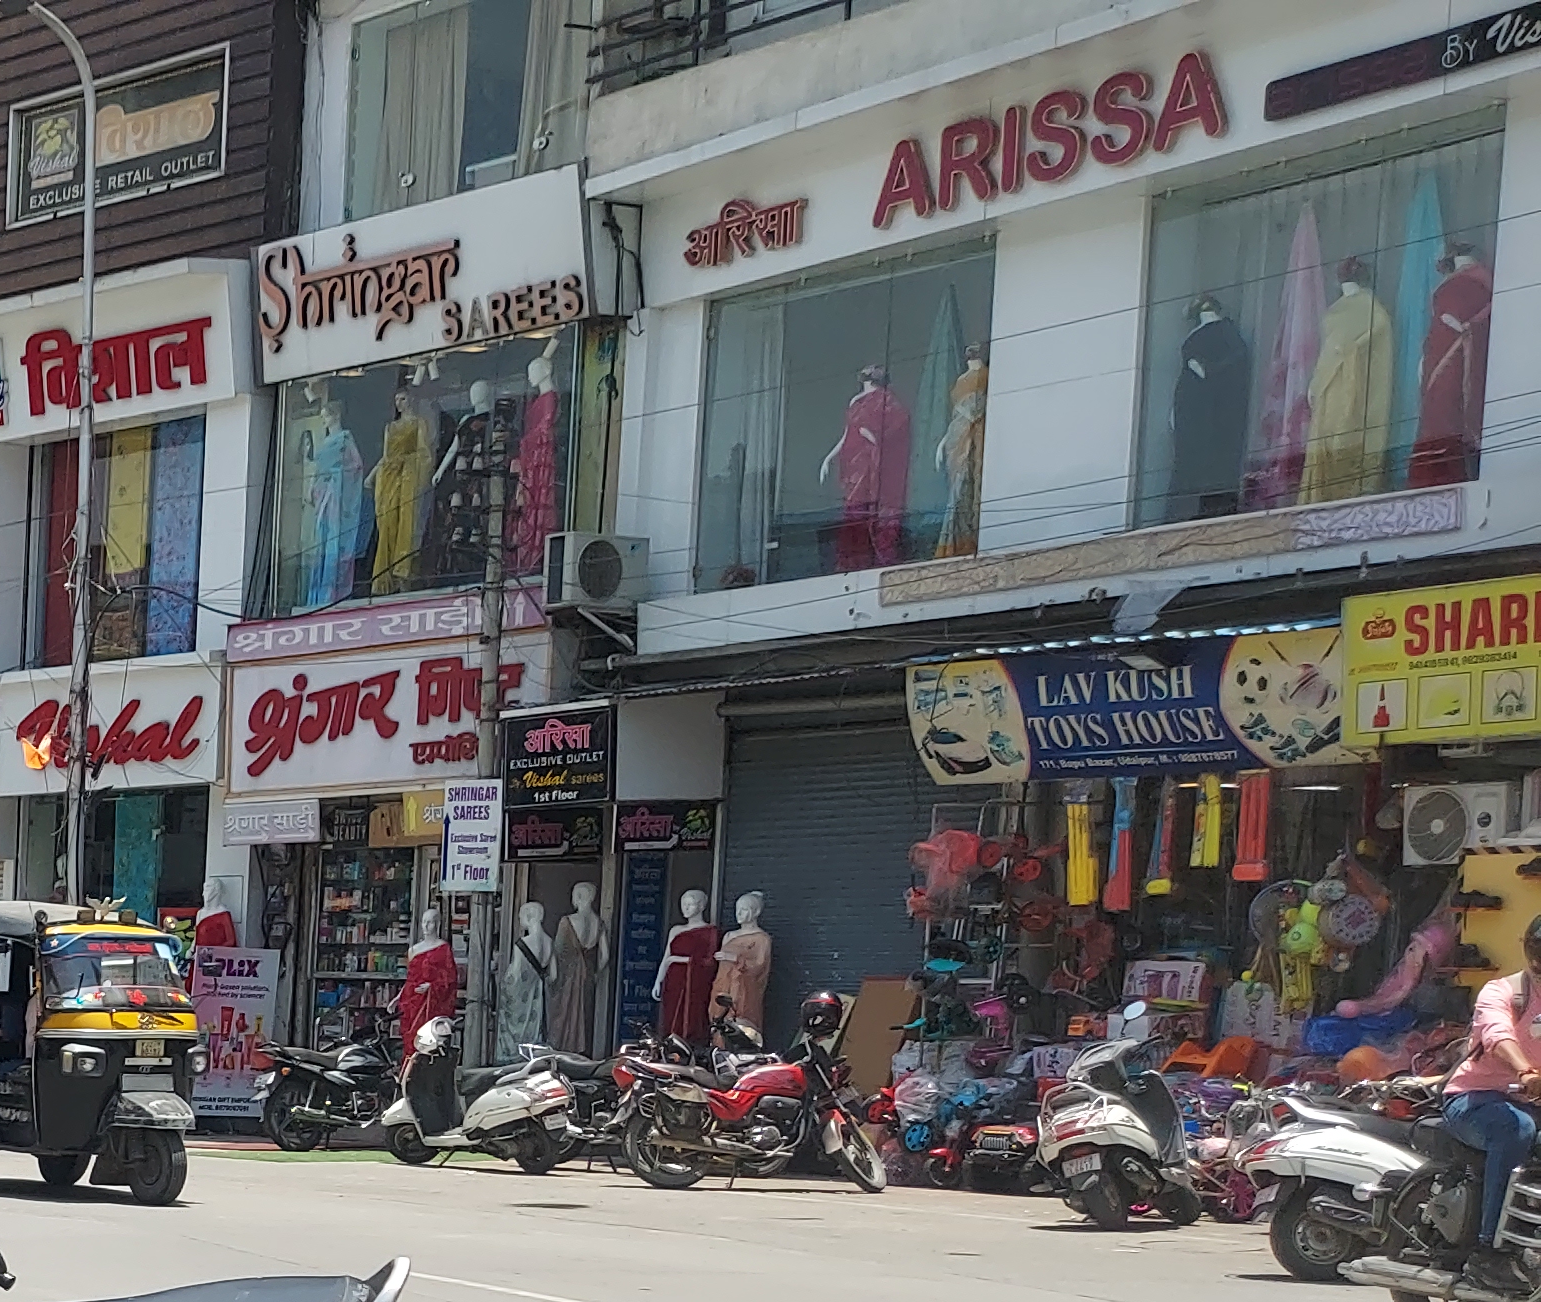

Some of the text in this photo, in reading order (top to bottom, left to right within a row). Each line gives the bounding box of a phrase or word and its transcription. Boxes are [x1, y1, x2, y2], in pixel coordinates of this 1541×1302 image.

[872, 49, 1229, 230] ARISSA
[29, 180, 101, 210] EXCLUSIE
[108, 167, 154, 191] RETAIL
[161, 150, 215, 176] OUTLET
[683, 198, 809, 268] अरिसा
[260, 233, 584, 354] Shringar SAREES
[20, 320, 212, 417] विशाल
[1404, 591, 1541, 656] SHAR
[1036, 665, 1196, 707] LAV KUSH
[524, 718, 592, 753] अरिसा
[1027, 706, 1225, 750] TOYS HOUSE
[447, 786, 498, 802] SHRINGAR
[522, 769, 568, 788] Vishal
[552, 789, 579, 801] Floor
[452, 805, 491, 821] SAREES
[464, 862, 492, 883] Floor
